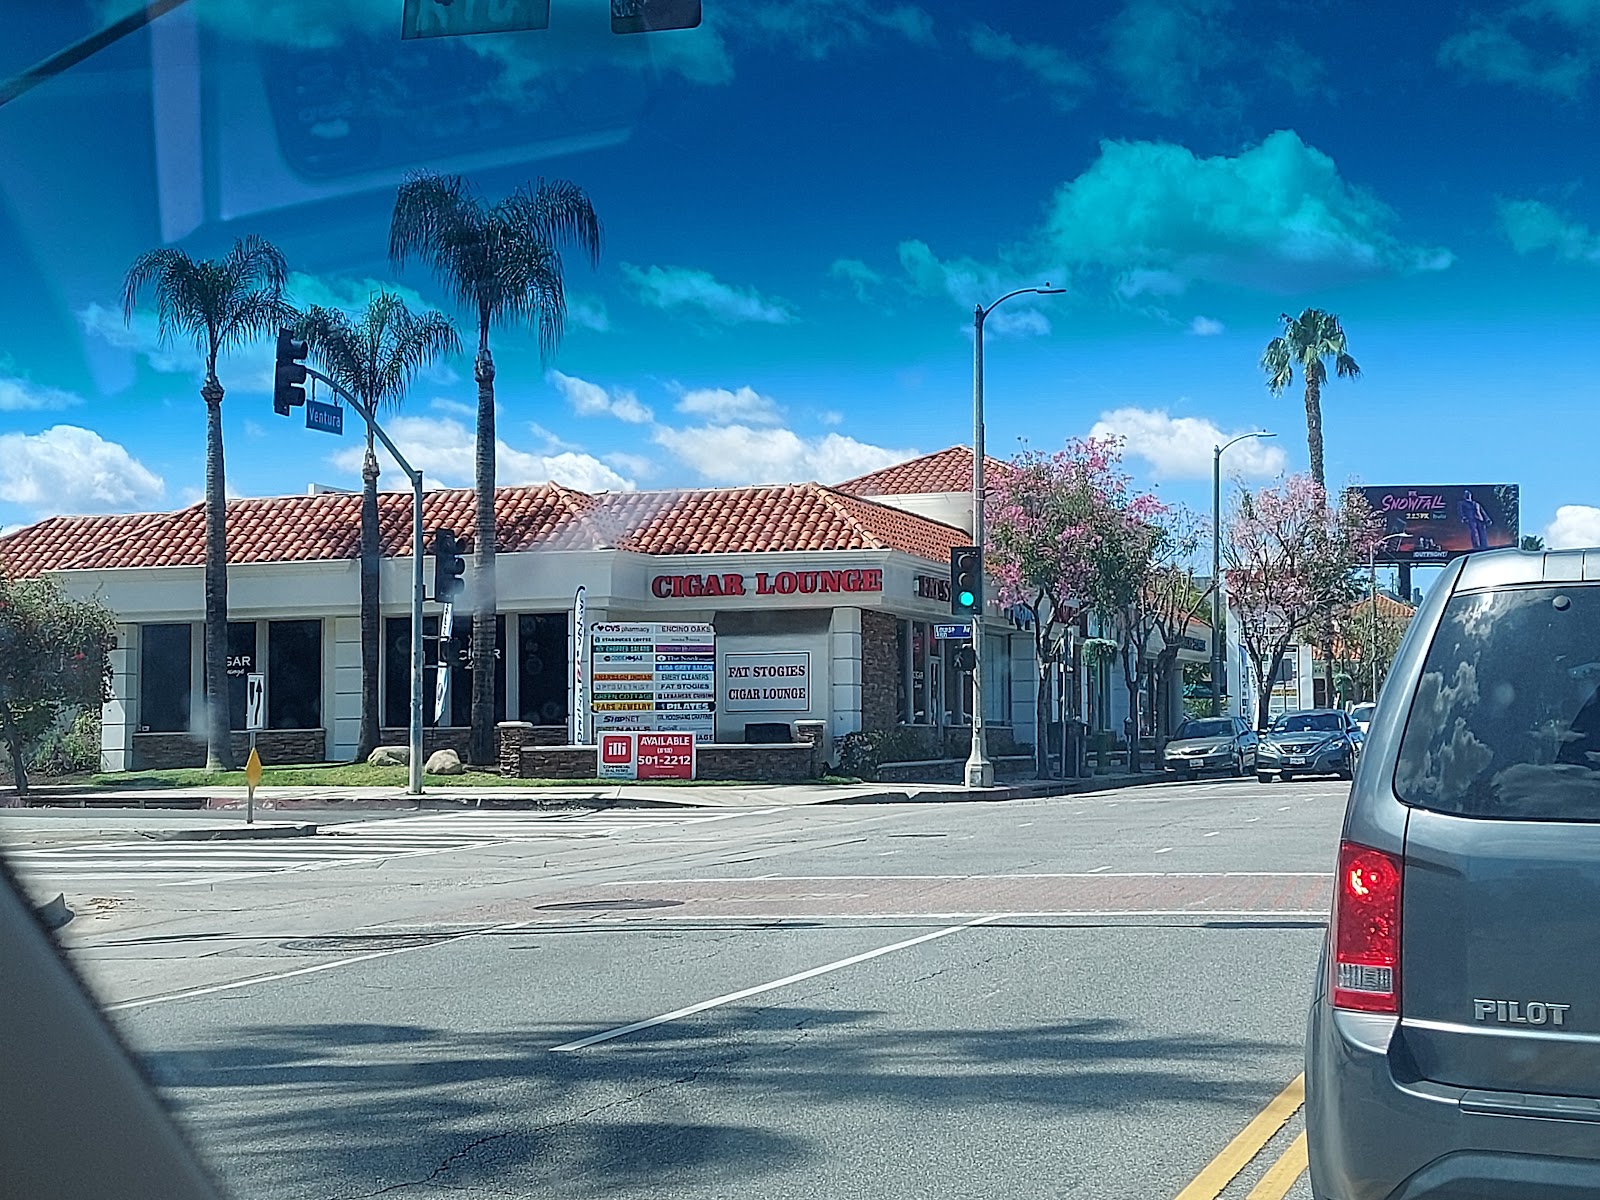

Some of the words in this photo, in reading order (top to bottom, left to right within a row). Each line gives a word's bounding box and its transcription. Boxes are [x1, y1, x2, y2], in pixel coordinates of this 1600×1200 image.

[308, 405, 341, 428] Ventura
[1382, 494, 1446, 511] SNOWFALL
[652, 573, 746, 598] CIGAR
[755, 569, 883, 595] LOUNGE
[728, 667, 750, 678] FAT
[753, 665, 806, 677] STOGIES
[728, 689, 760, 700] CIGAR
[763, 687, 806, 699] LOUNGE
[618, 703, 652, 711] JEWELRY
[666, 702, 709, 710] PILATES
[640, 736, 690, 746] AVAILABLE
[638, 756, 691, 765] 501-2212
[1473, 998, 1571, 1025] PILOT
